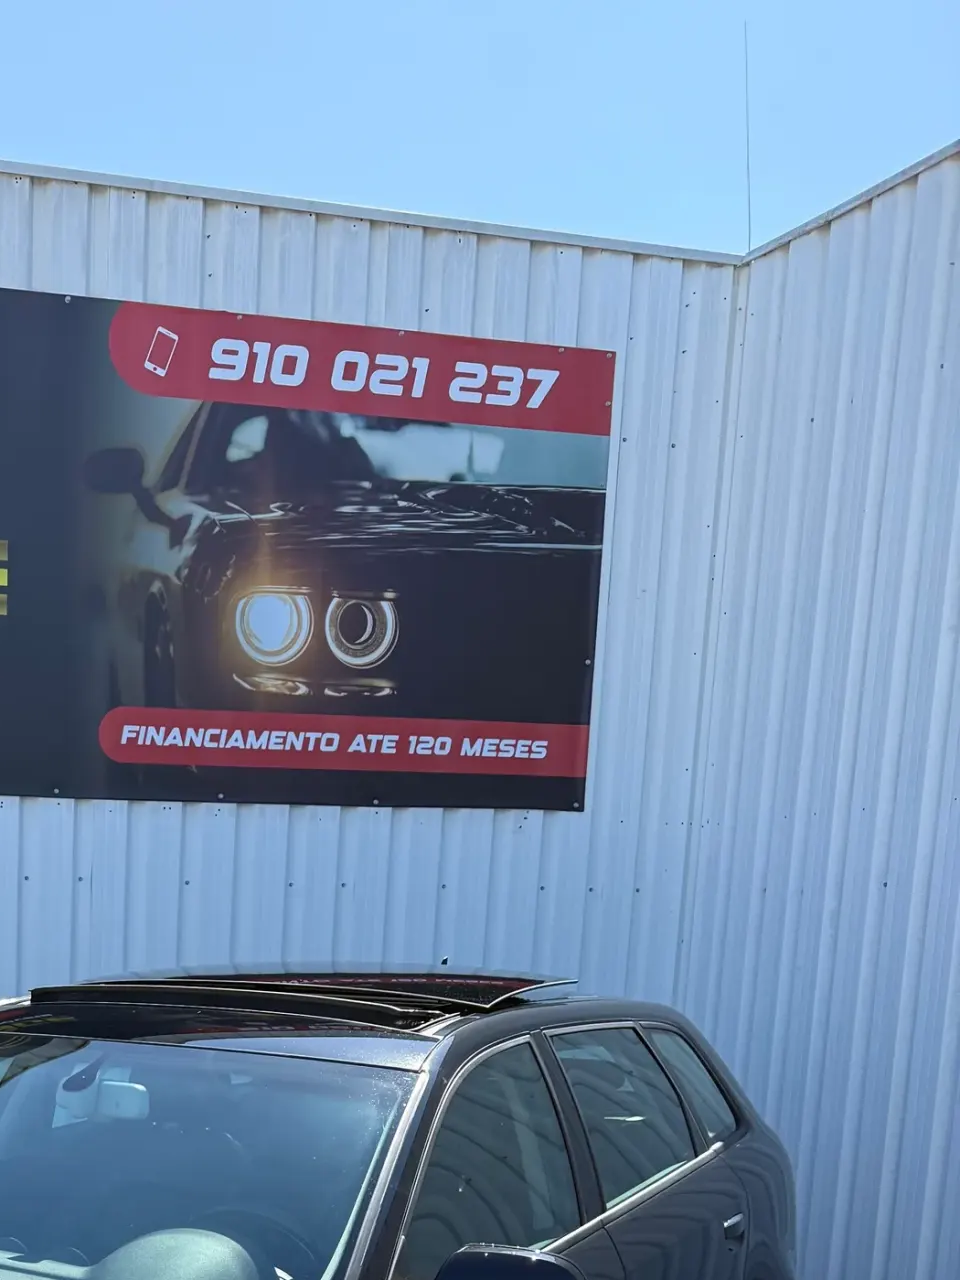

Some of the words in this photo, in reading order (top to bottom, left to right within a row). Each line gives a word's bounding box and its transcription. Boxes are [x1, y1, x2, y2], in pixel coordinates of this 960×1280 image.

[208, 338, 310, 386] 910
[330, 350, 430, 398] 021
[448, 362, 560, 409] 237
[120, 725, 340, 752] FINANCIAMENTO
[347, 733, 399, 754] ATE
[408, 735, 452, 756] 120
[460, 737, 548, 759] MESES
